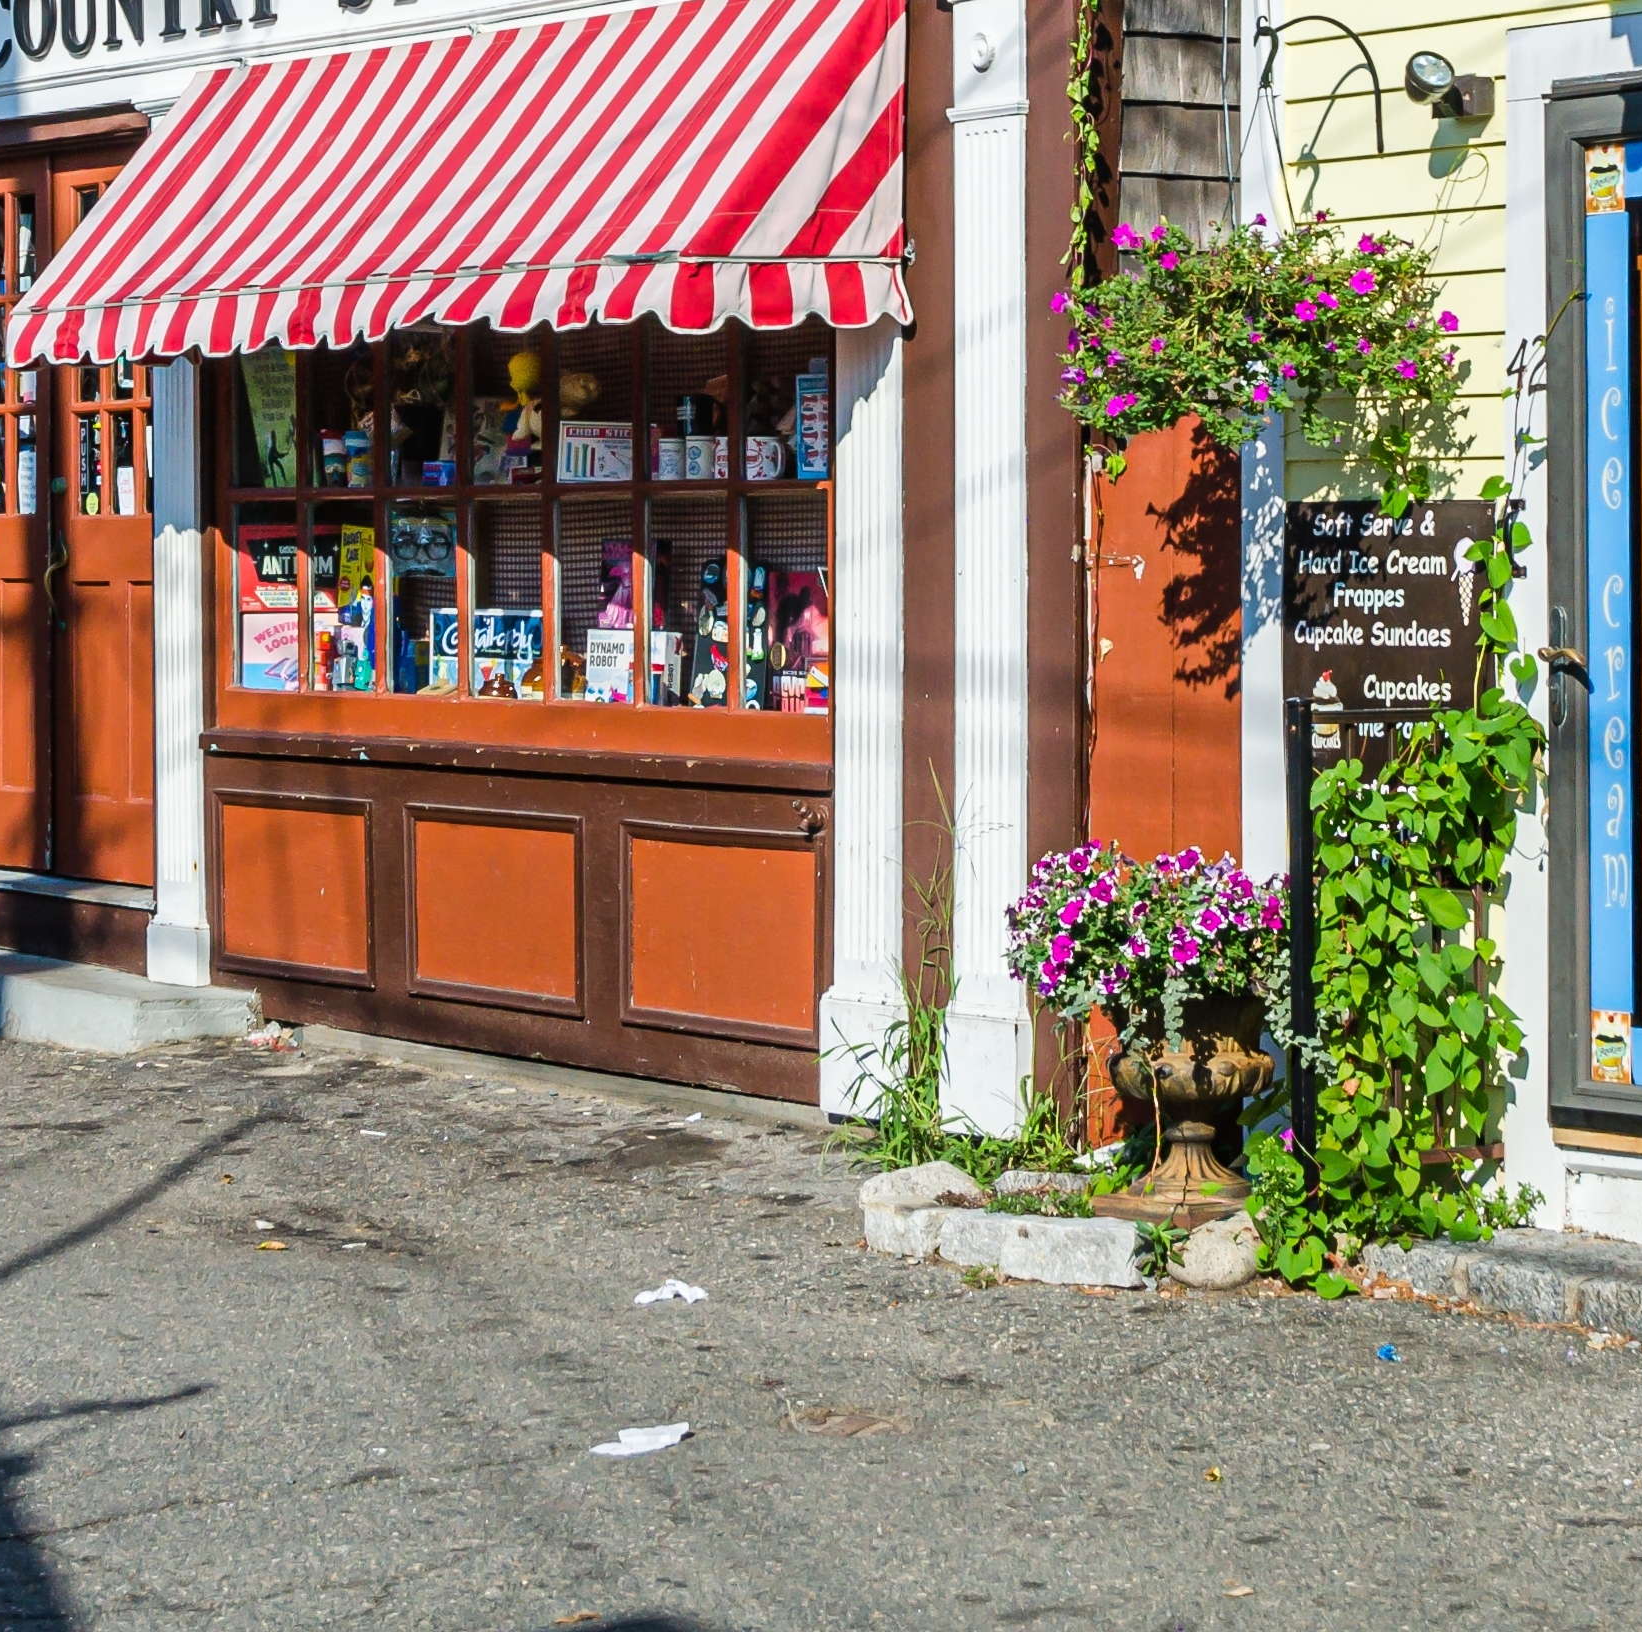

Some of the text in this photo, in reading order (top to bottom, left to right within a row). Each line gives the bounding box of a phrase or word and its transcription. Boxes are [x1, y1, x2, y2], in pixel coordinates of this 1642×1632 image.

[605, 428, 632, 437] STIC
[80, 427, 88, 487] PUSH
[1313, 509, 1435, 538] Soft Serve &
[262, 555, 291, 576] ANT
[1298, 548, 1447, 576] Hard Ice Cream
[1333, 581, 1405, 616] Frappes
[1600, 295, 1629, 909] ice cream
[253, 621, 298, 644] WEAVIN
[1294, 618, 1452, 652] Cupcake Sundaes
[589, 641, 625, 655] DYNAMO
[589, 654, 618, 668] ROBOT
[1363, 673, 1452, 708] Cupcakes
